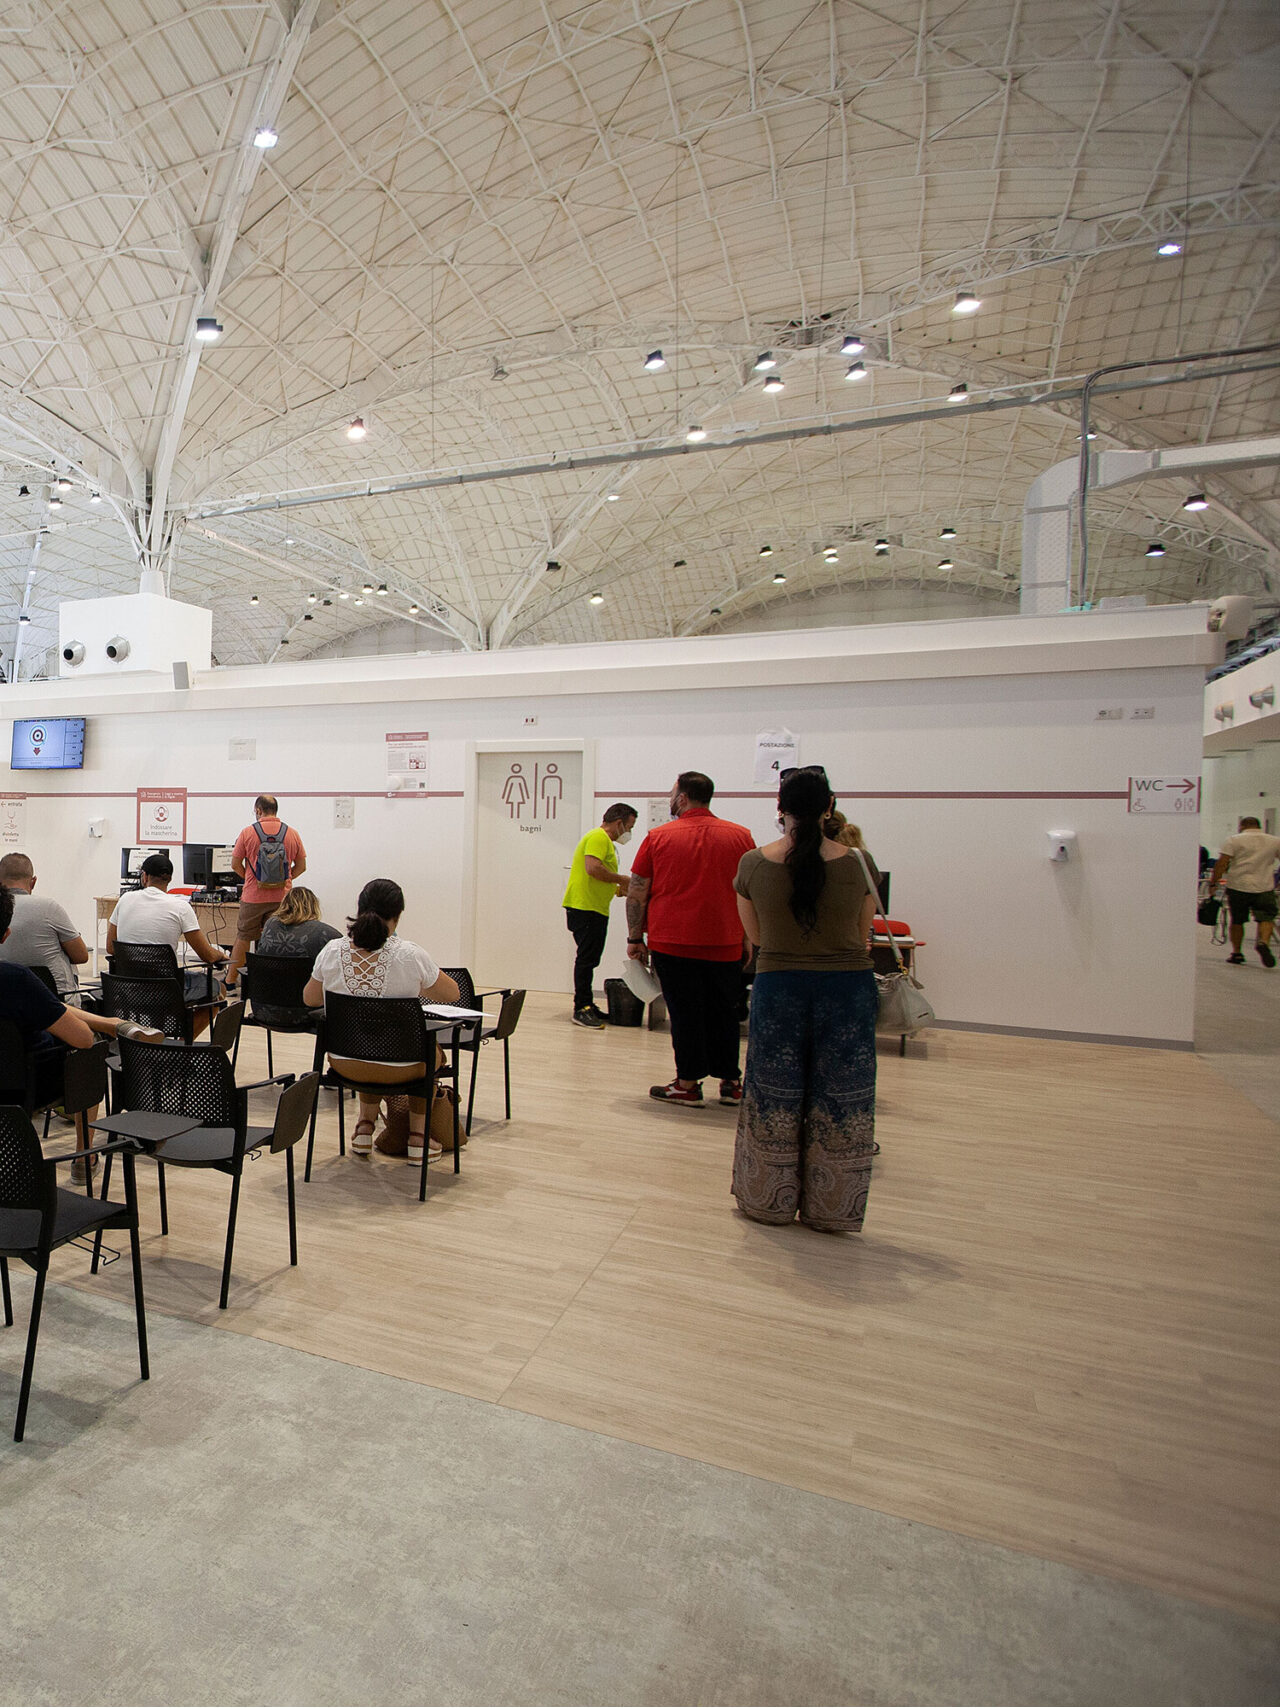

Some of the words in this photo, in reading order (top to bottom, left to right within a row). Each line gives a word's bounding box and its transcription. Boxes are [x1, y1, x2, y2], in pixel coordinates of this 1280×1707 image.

[771, 760, 780, 771] 4
[1135, 780, 1164, 791] WC
[520, 825, 542, 834] bagni
